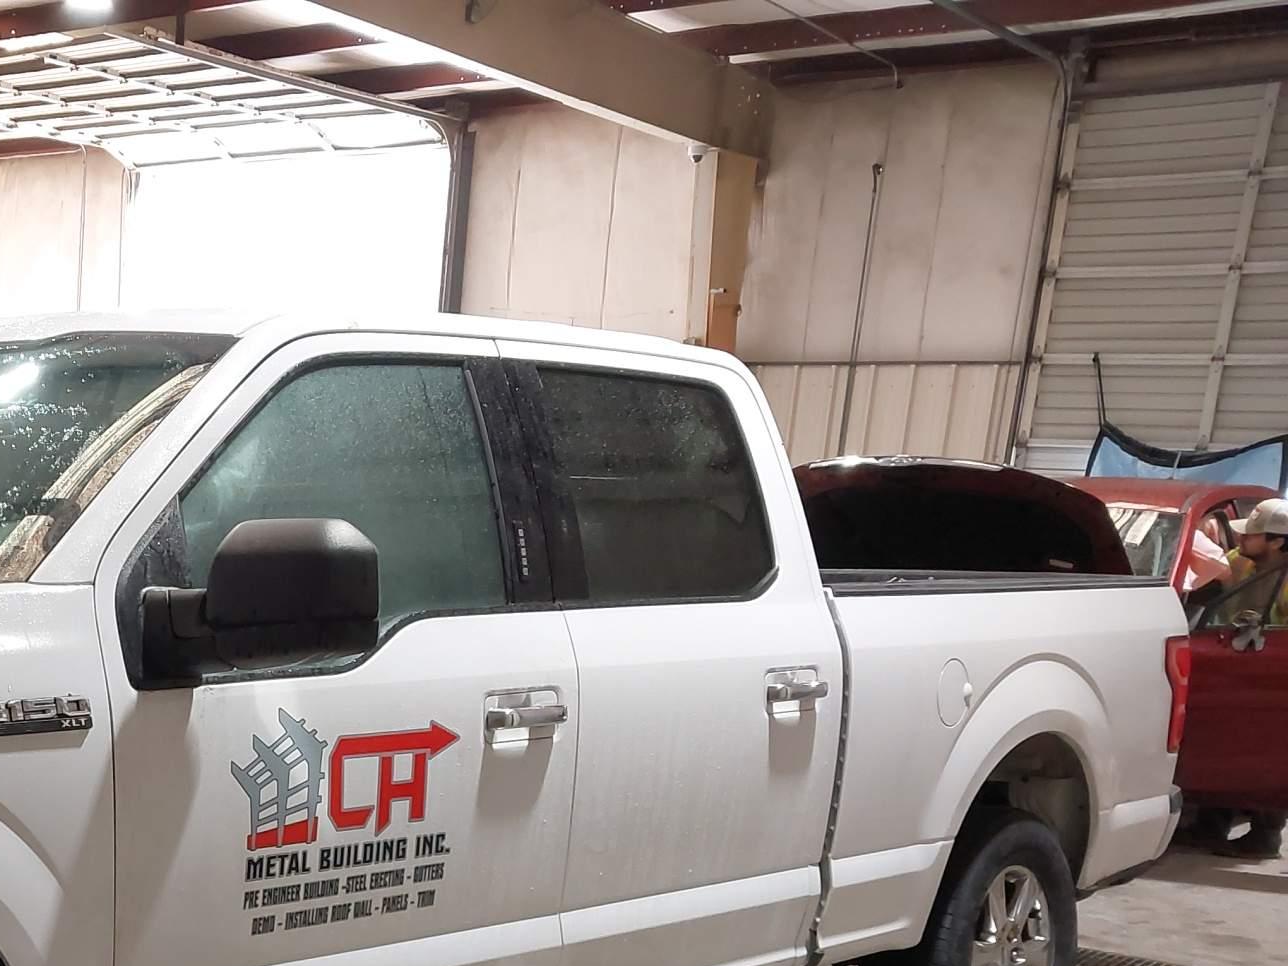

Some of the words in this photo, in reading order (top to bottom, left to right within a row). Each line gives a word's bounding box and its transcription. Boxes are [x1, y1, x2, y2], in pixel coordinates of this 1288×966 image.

[61, 718, 88, 728] XLT
[246, 850, 311, 882] METAL
[319, 837, 407, 872] BUILDING
[414, 833, 451, 858] INC.
[243, 890, 261, 910] PRE
[262, 884, 301, 907] ENGINEER
[303, 878, 340, 901] BUILDING
[369, 868, 405, 891] ERECTING
[413, 862, 445, 883] GUTTERS
[251, 915, 276, 936] DEMO
[284, 906, 329, 930] INSTALLING
[330, 902, 352, 923] ROOF
[353, 899, 373, 919] WALL
[381, 893, 409, 914] PANELS
[417, 889, 436, 908] TRIM
